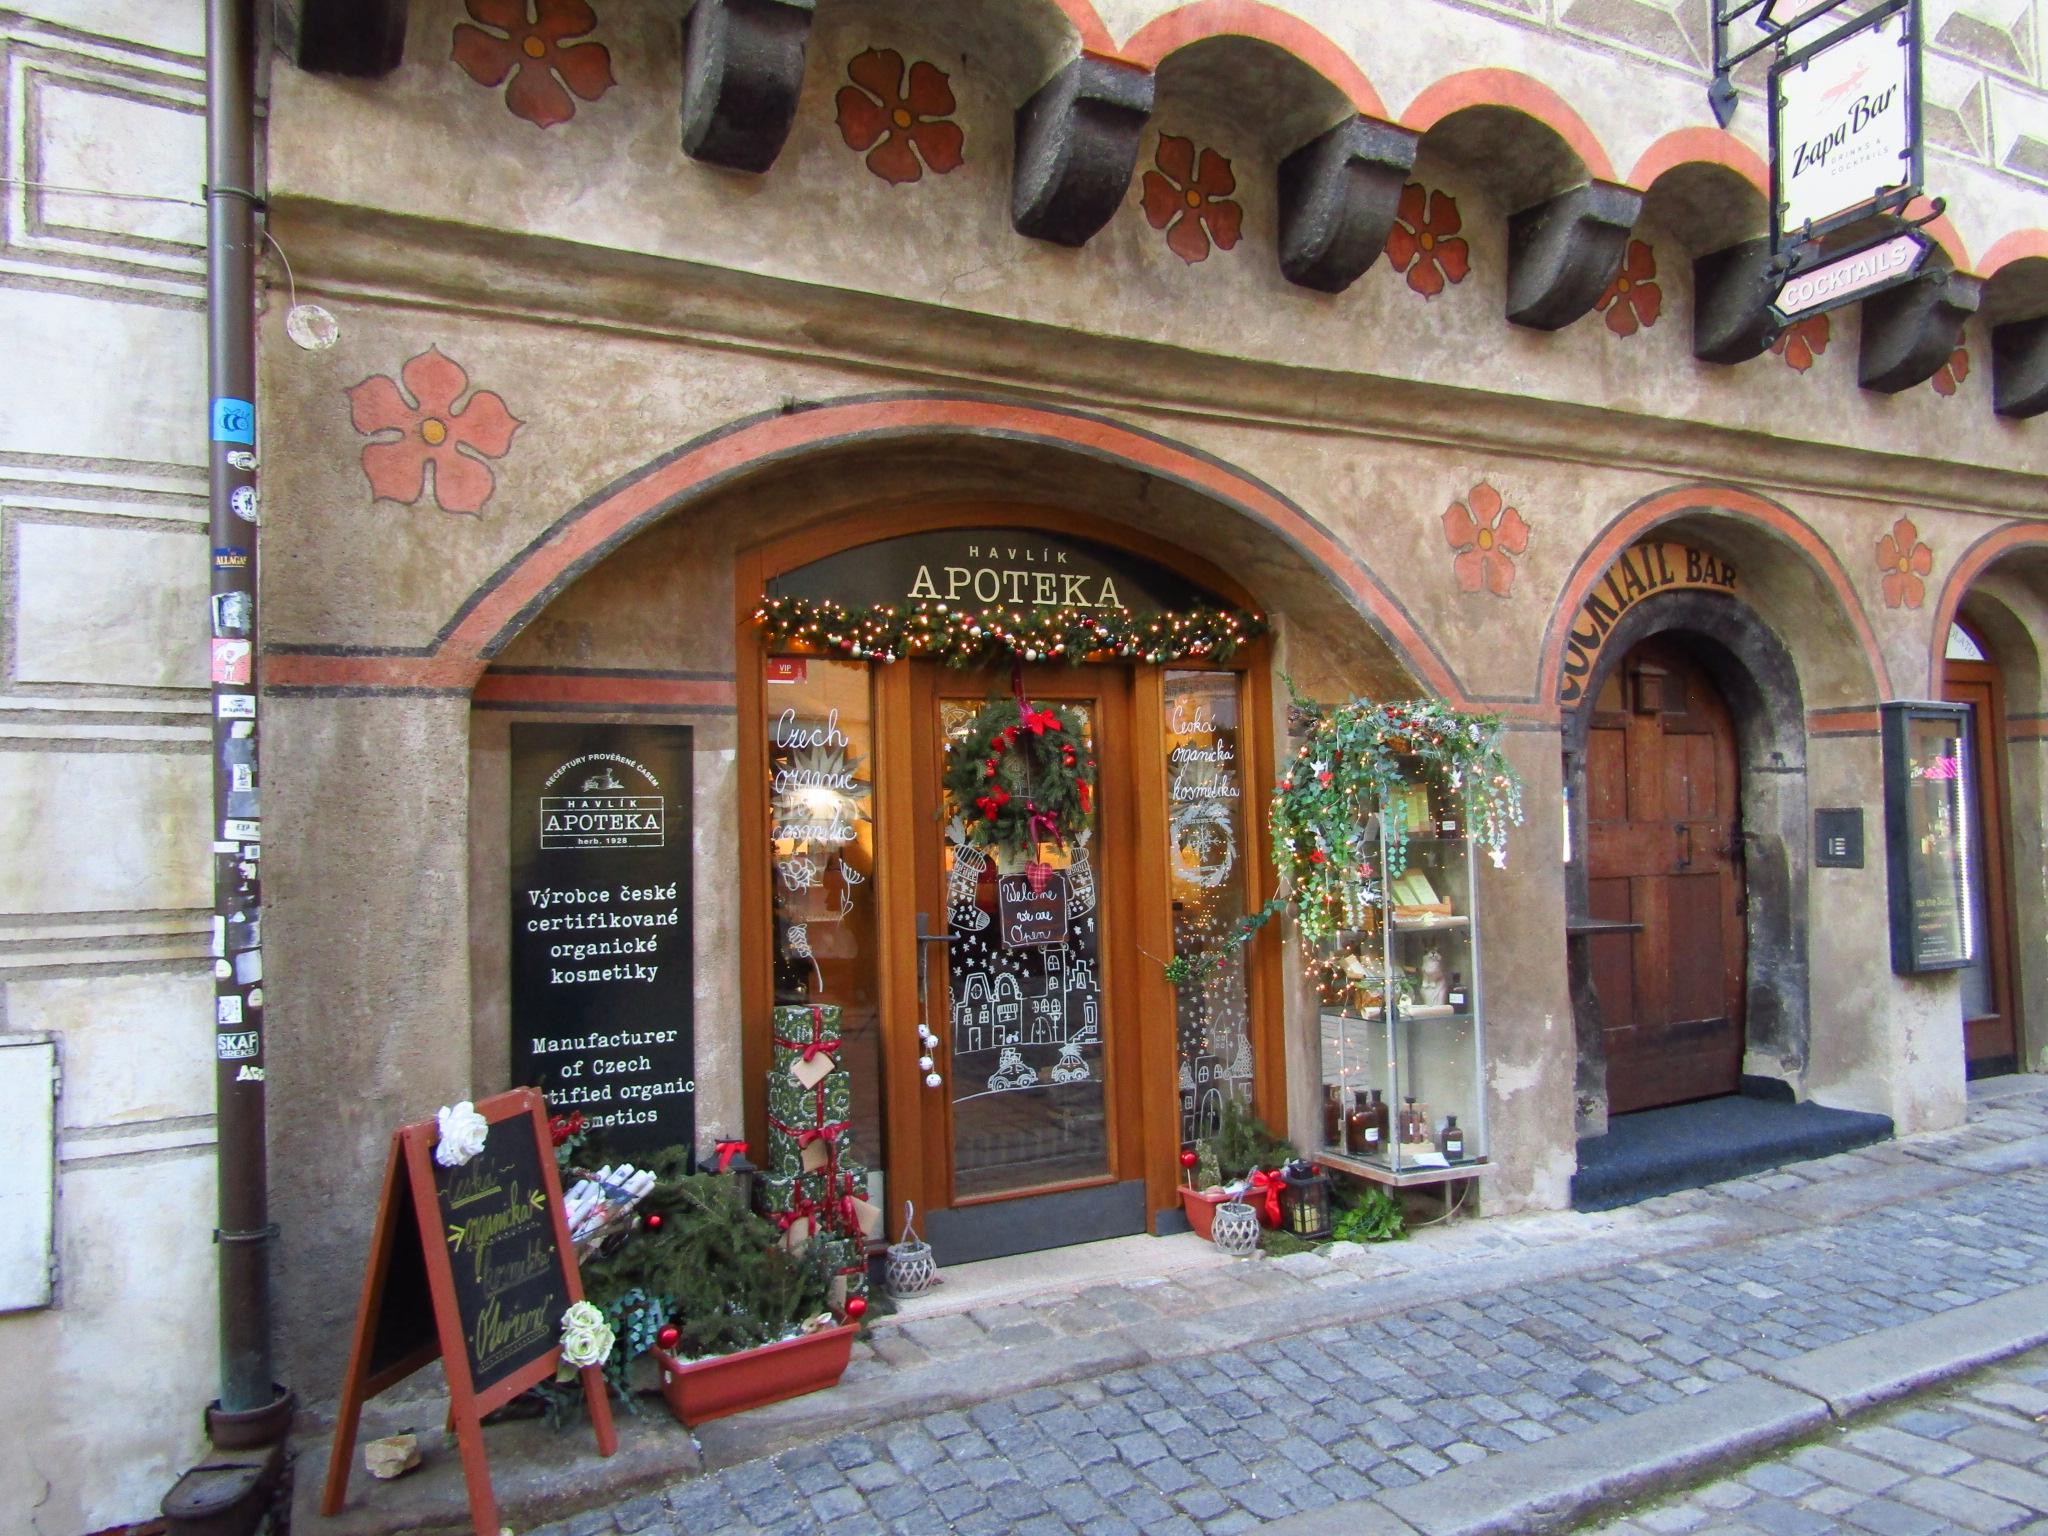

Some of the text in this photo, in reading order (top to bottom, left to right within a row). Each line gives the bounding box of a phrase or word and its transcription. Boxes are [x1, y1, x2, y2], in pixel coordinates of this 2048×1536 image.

[1792, 84, 1897, 179] Zapa Bar
[1786, 245, 1908, 306] COCKTAILS
[968, 545, 1069, 565] HAVLÍK
[1685, 548, 1737, 589] BAR
[907, 565, 1125, 609] APOTEKA
[779, 664, 792, 672] VIP
[777, 708, 849, 749] Czech
[1172, 738, 1234, 777] organická
[545, 755, 586, 788] RECEPTURY
[636, 764, 660, 788] ČASEM
[775, 767, 858, 794] organic
[1173, 773, 1240, 801] kosmetika
[567, 798, 638, 809] HAVLÍK
[544, 813, 661, 832] APOTEKA
[578, 836, 628, 846] herb. 1928
[528, 881, 678, 909] Výrobce české
[527, 907, 679, 933] certifikované
[1010, 924, 1051, 944] Open
[551, 934, 658, 961] organické
[551, 963, 659, 984] kosmetiky
[532, 1029, 678, 1054] Manufacturer
[561, 1055, 652, 1078] of Czech
[620, 1077, 696, 1101] organic
